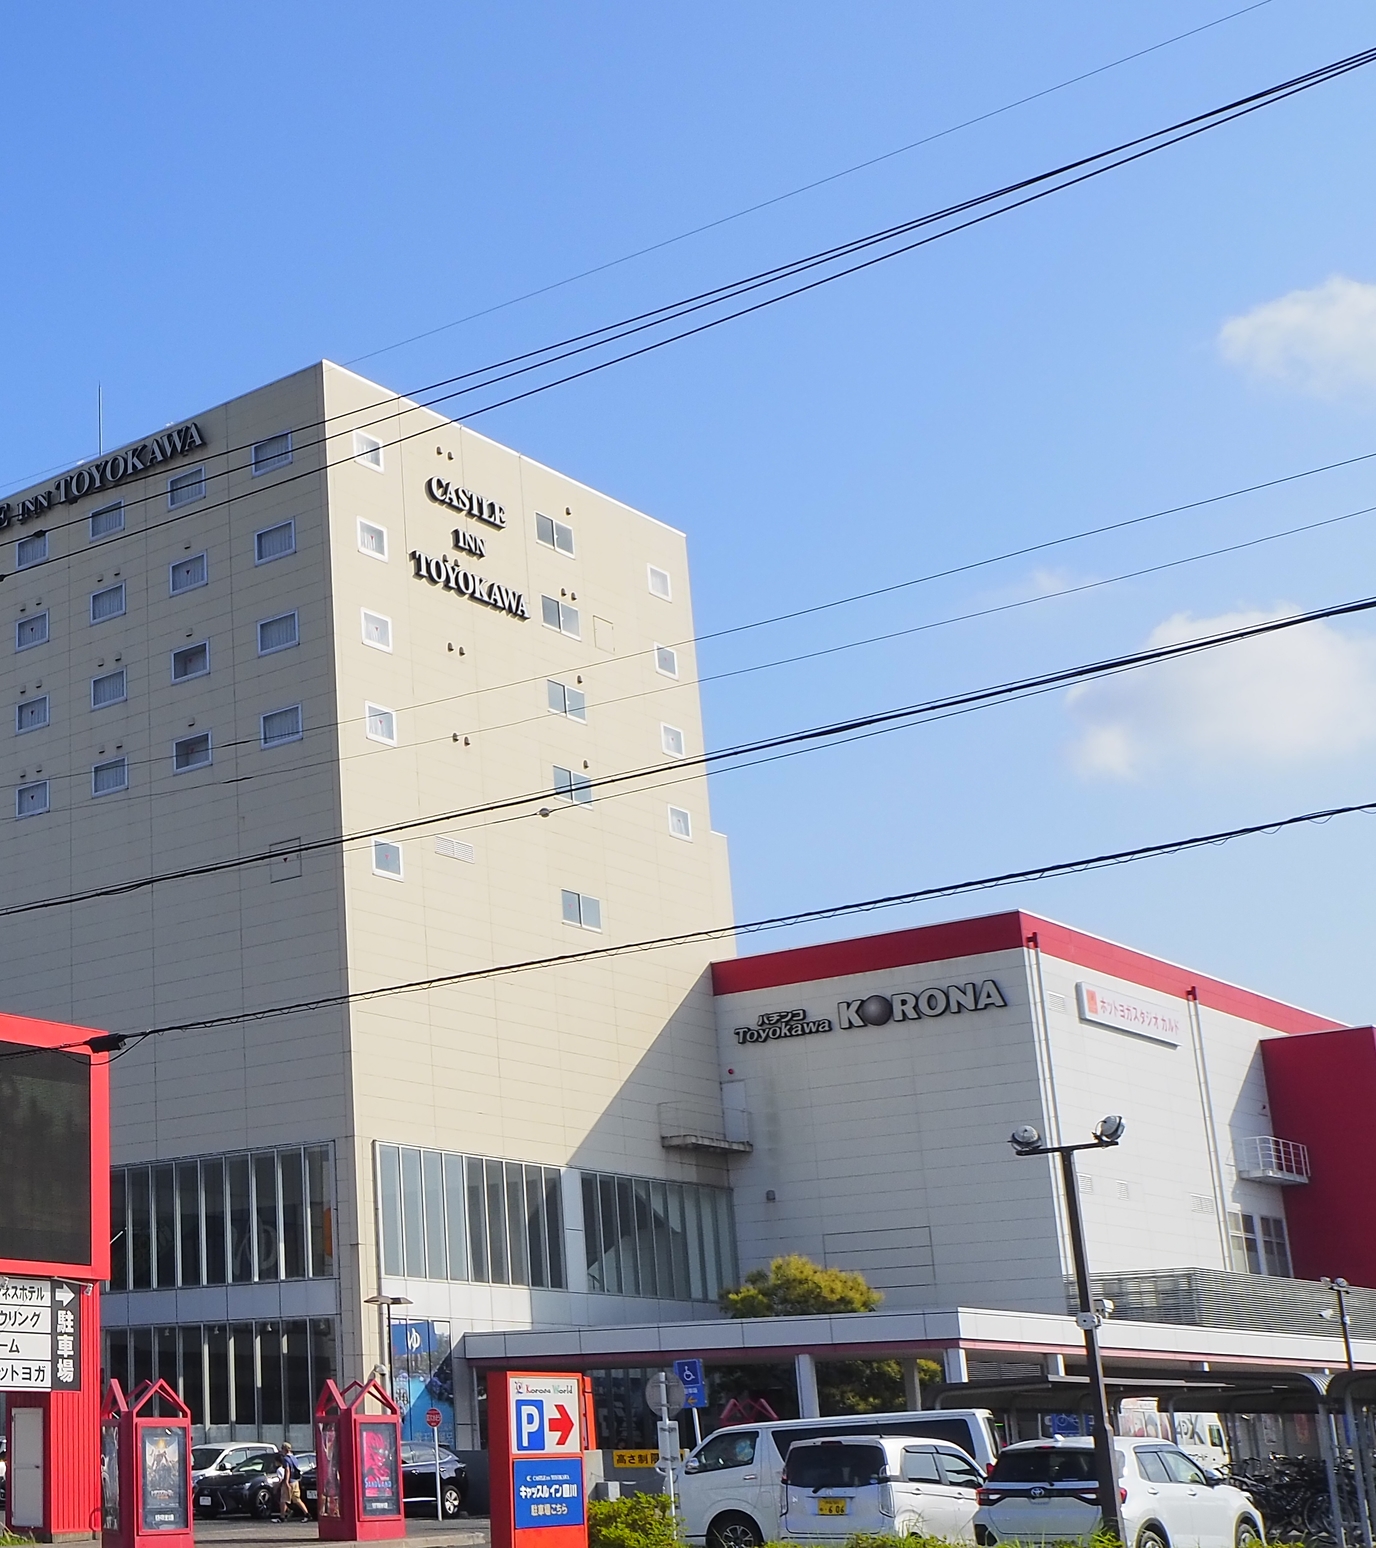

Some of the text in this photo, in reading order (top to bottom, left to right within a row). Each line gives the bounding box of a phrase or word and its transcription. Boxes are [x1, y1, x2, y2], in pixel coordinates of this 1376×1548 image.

[17, 491, 53, 522] INN
[55, 422, 205, 502] TOYOKAWA
[425, 476, 507, 531] CASTLE
[451, 528, 487, 559] INN
[409, 550, 531, 622] TOYOKAWA
[734, 1018, 832, 1044] Toyokawa
[757, 1008, 806, 1026] パチンコ
[56, 1310, 74, 1383] 駐車場
[526, 1384, 573, 1394] Korona World
[520, 1405, 540, 1447] P
